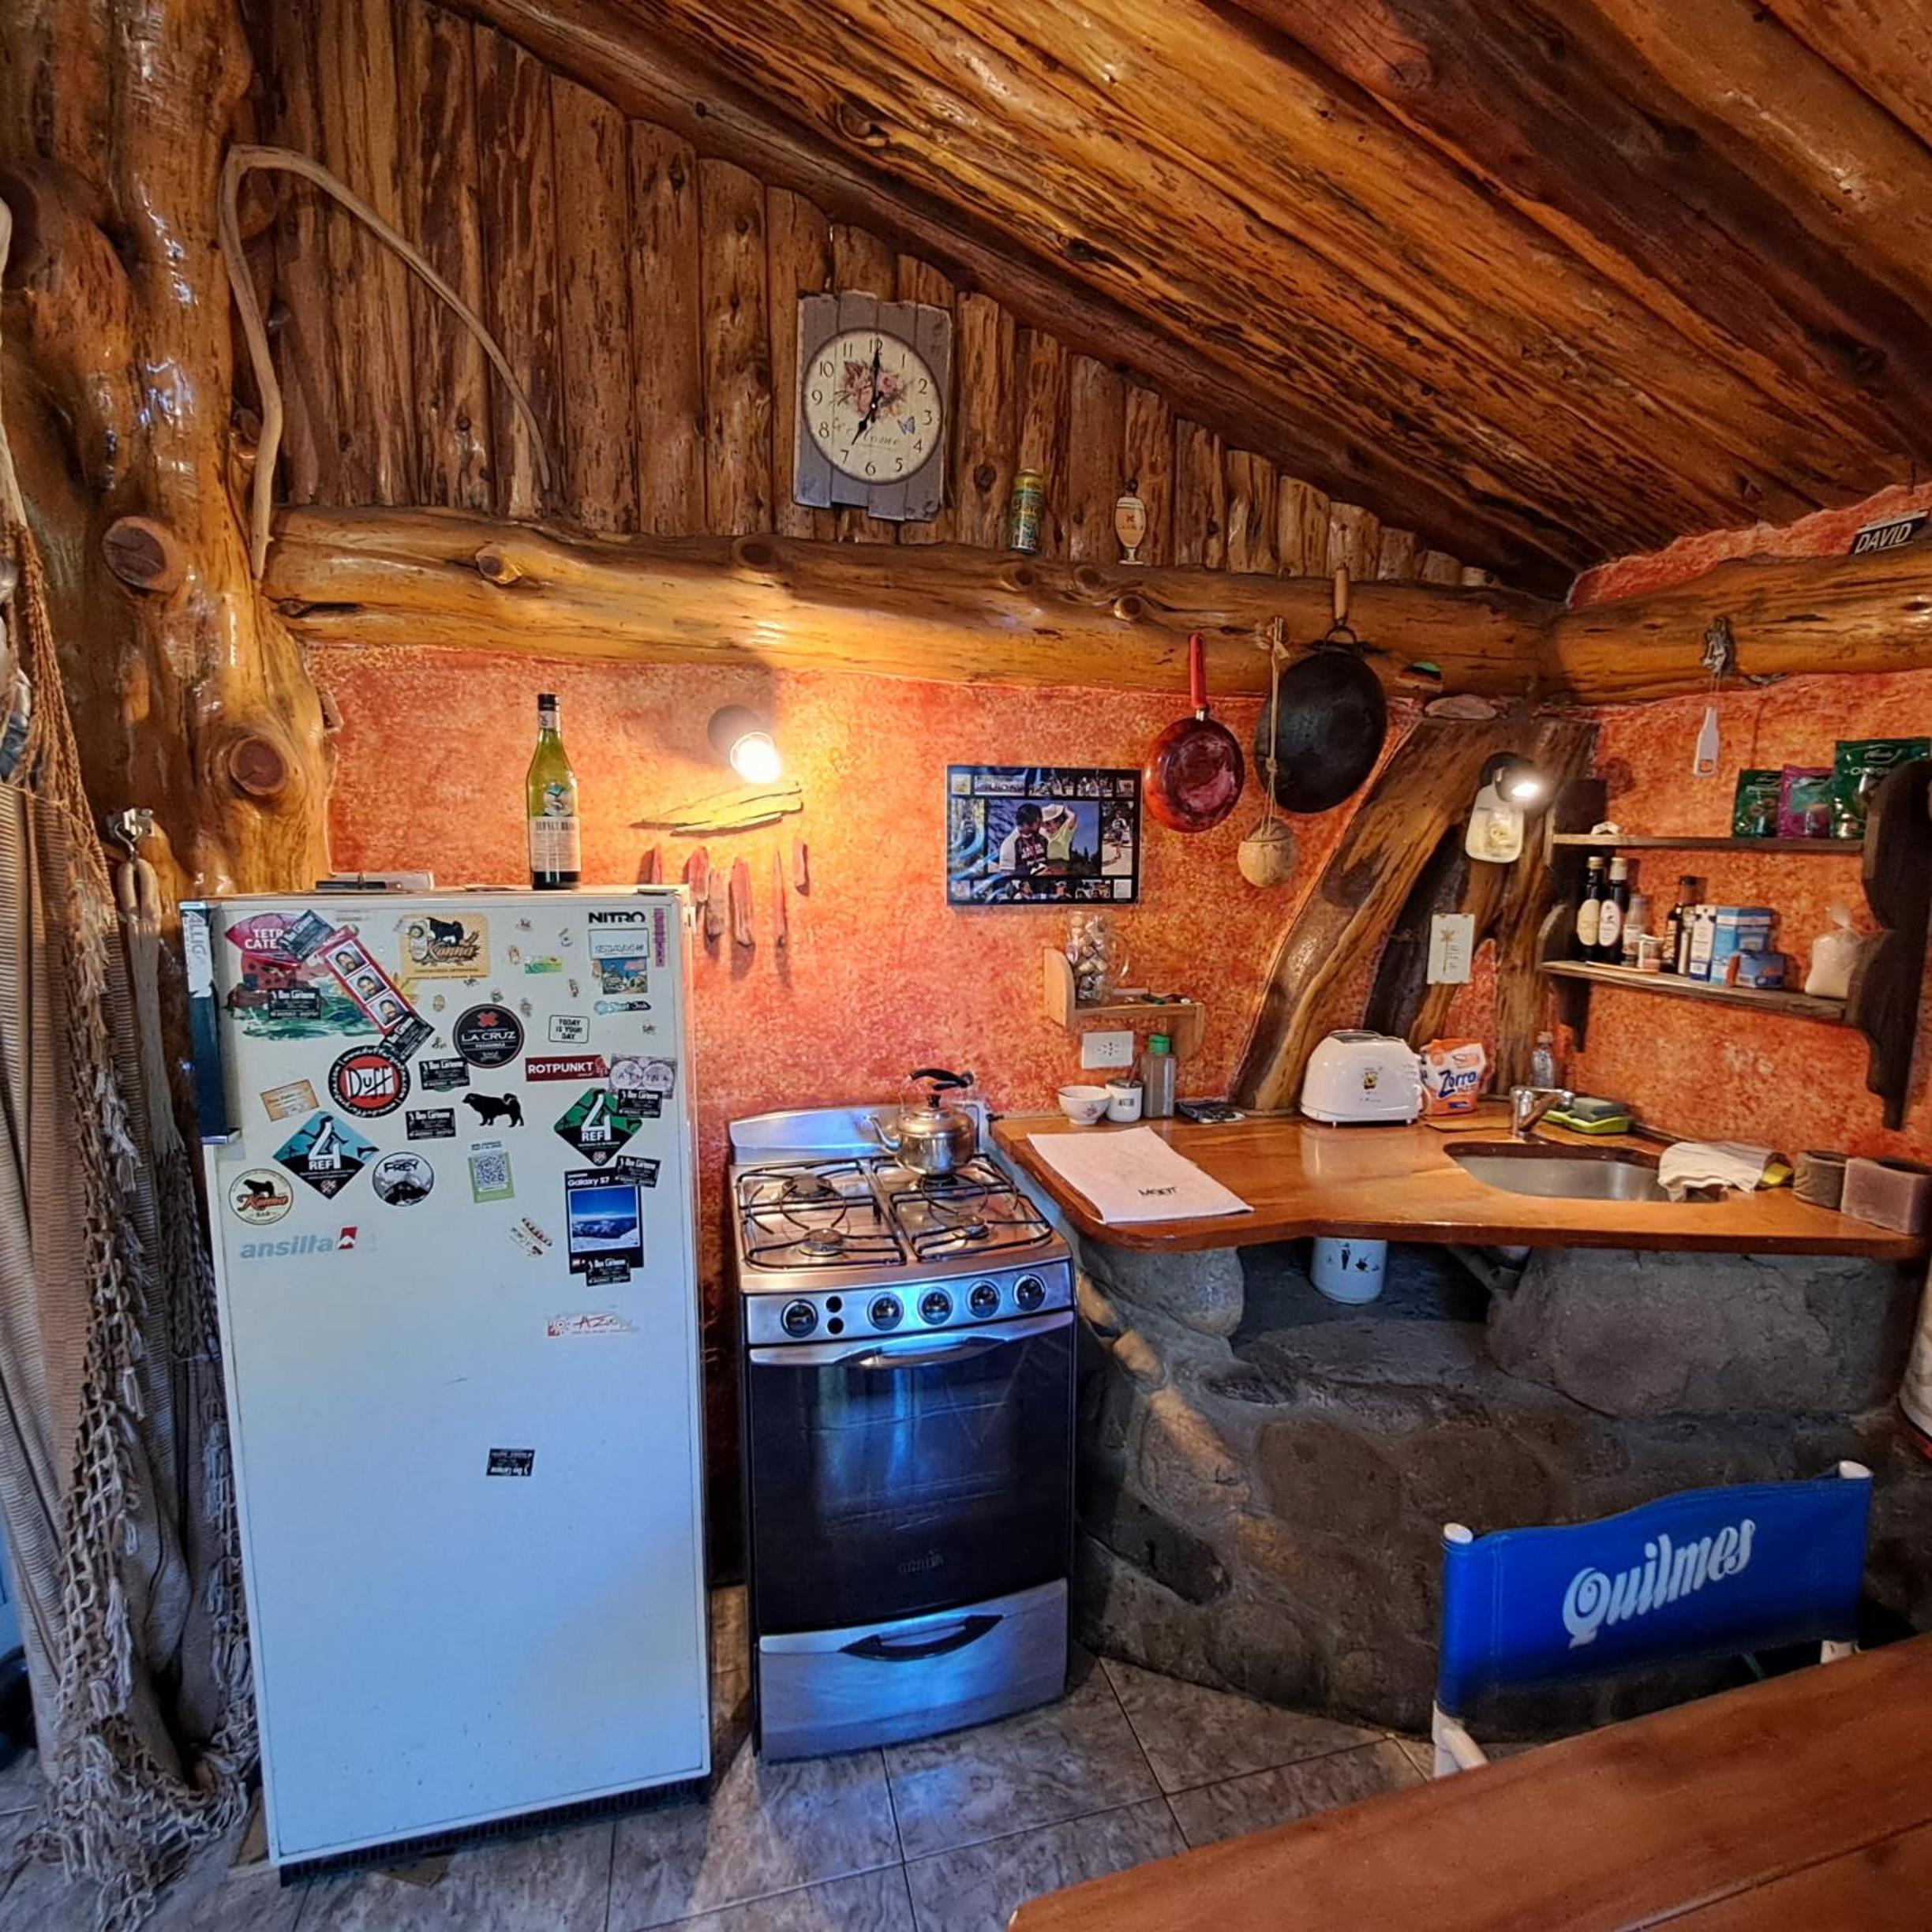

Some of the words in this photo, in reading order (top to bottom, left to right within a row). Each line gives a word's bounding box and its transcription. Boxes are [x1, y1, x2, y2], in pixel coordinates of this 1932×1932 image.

[843, 342, 853, 358] 11
[869, 338, 883, 354] 12
[818, 360, 834, 378] 10
[918, 377, 927, 395] 2
[811, 389, 823, 406] 9
[921, 410, 932, 425] 3
[818, 421, 830, 439] 8
[912, 438, 923, 453] 4
[840, 449, 850, 464] 7
[894, 456, 904, 473] 5
[865, 461, 876, 476] 6
[1855, 522, 1912, 554] DAVID
[588, 911, 646, 923] NITRO
[190, 912, 207, 958] ALLIG
[252, 928, 284, 938] TETR
[244, 938, 279, 949] CATE
[481, 1031, 516, 1041] CRUZ
[527, 1061, 593, 1074] ROTPUNKT
[1438, 1068, 1477, 1098] Zorro
[567, 1178, 597, 1187] Galaxy
[600, 1176, 610, 1185] S7
[240, 1235, 333, 1259] ansilta
[1563, 1518, 1756, 1649] Quilmes
